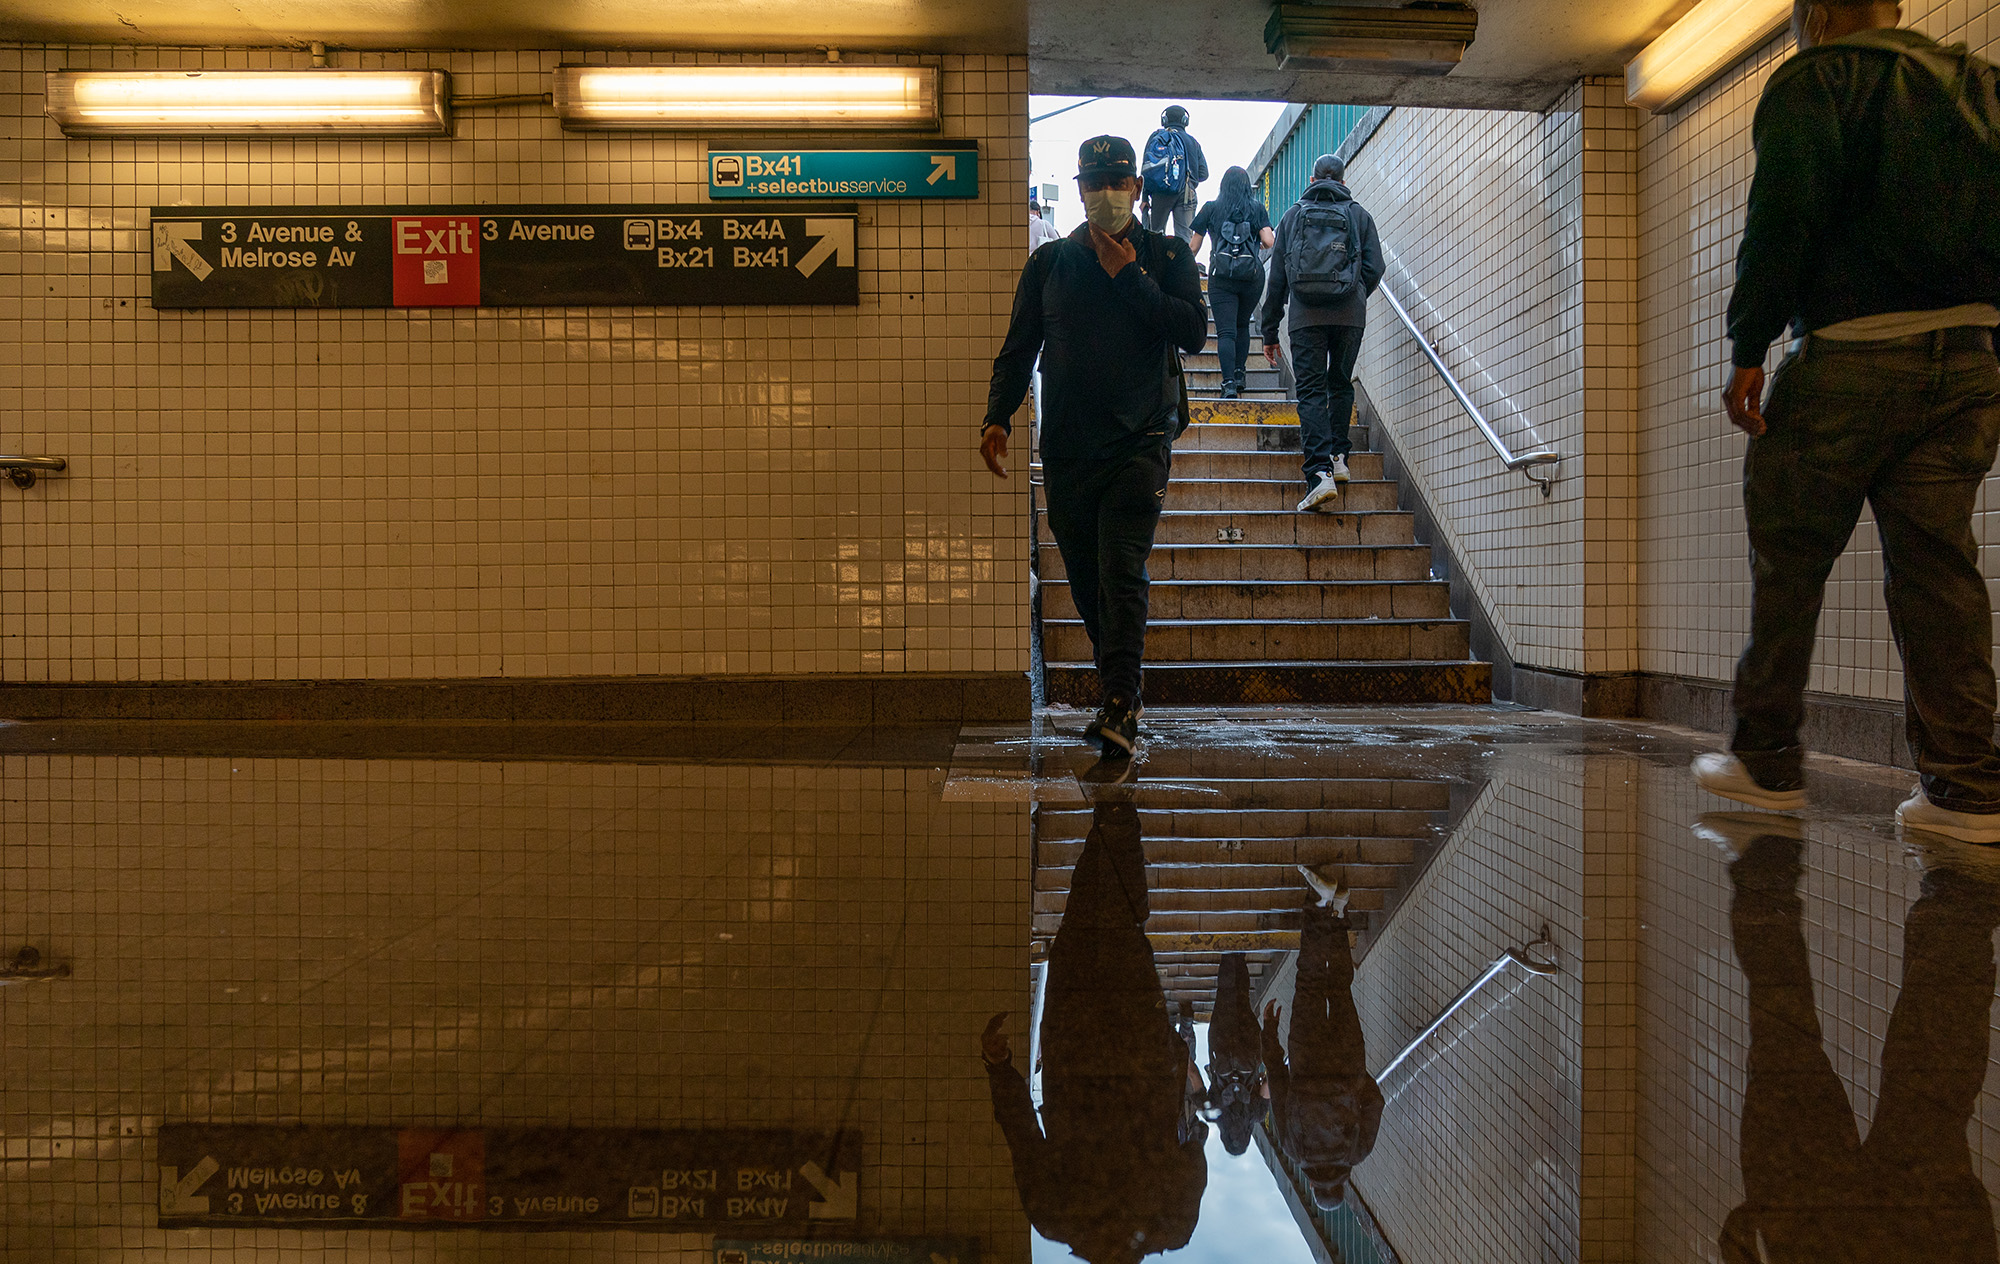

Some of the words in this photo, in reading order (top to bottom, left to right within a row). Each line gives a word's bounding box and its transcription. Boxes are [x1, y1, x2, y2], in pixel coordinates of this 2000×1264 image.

[746, 155, 801, 176] Bx41
[220, 221, 238, 243] 3
[246, 221, 335, 243] Avenue
[344, 220, 363, 242] &
[396, 220, 473, 255] Exit
[482, 219, 499, 241] 3
[508, 220, 595, 241] Avenue
[657, 219, 704, 240] Bx4
[723, 219, 786, 240] Bx4A
[220, 246, 318, 268] Melrose
[326, 246, 356, 267] Av
[657, 246, 714, 268] Bx21
[733, 246, 789, 268] Bx41
